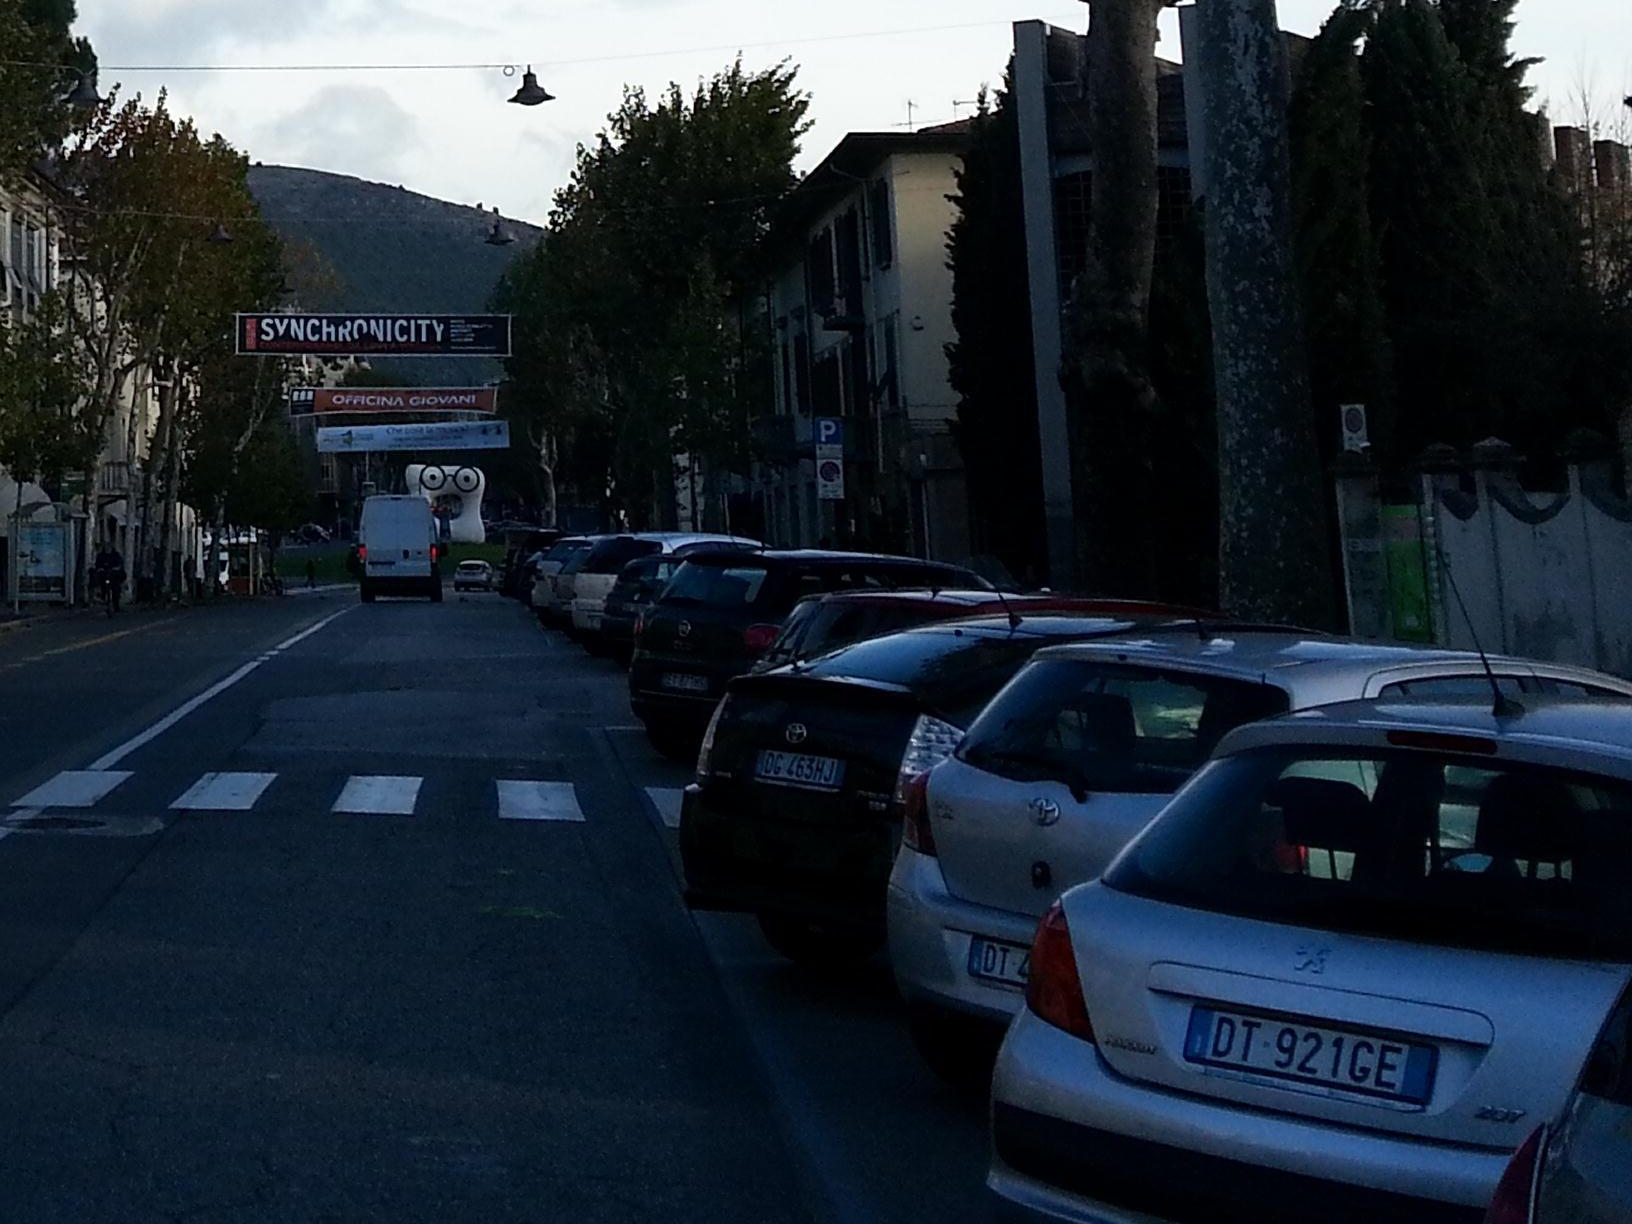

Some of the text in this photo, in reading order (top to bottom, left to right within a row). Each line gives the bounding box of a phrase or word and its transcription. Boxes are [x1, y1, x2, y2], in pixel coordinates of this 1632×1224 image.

[260, 317, 445, 343] SYNCHRONICITY
[332, 394, 476, 407] OFFICINA GIOVANI
[819, 419, 837, 443] P
[984, 944, 1010, 976] DT
[1211, 1017, 1405, 1091] DT 921GE
